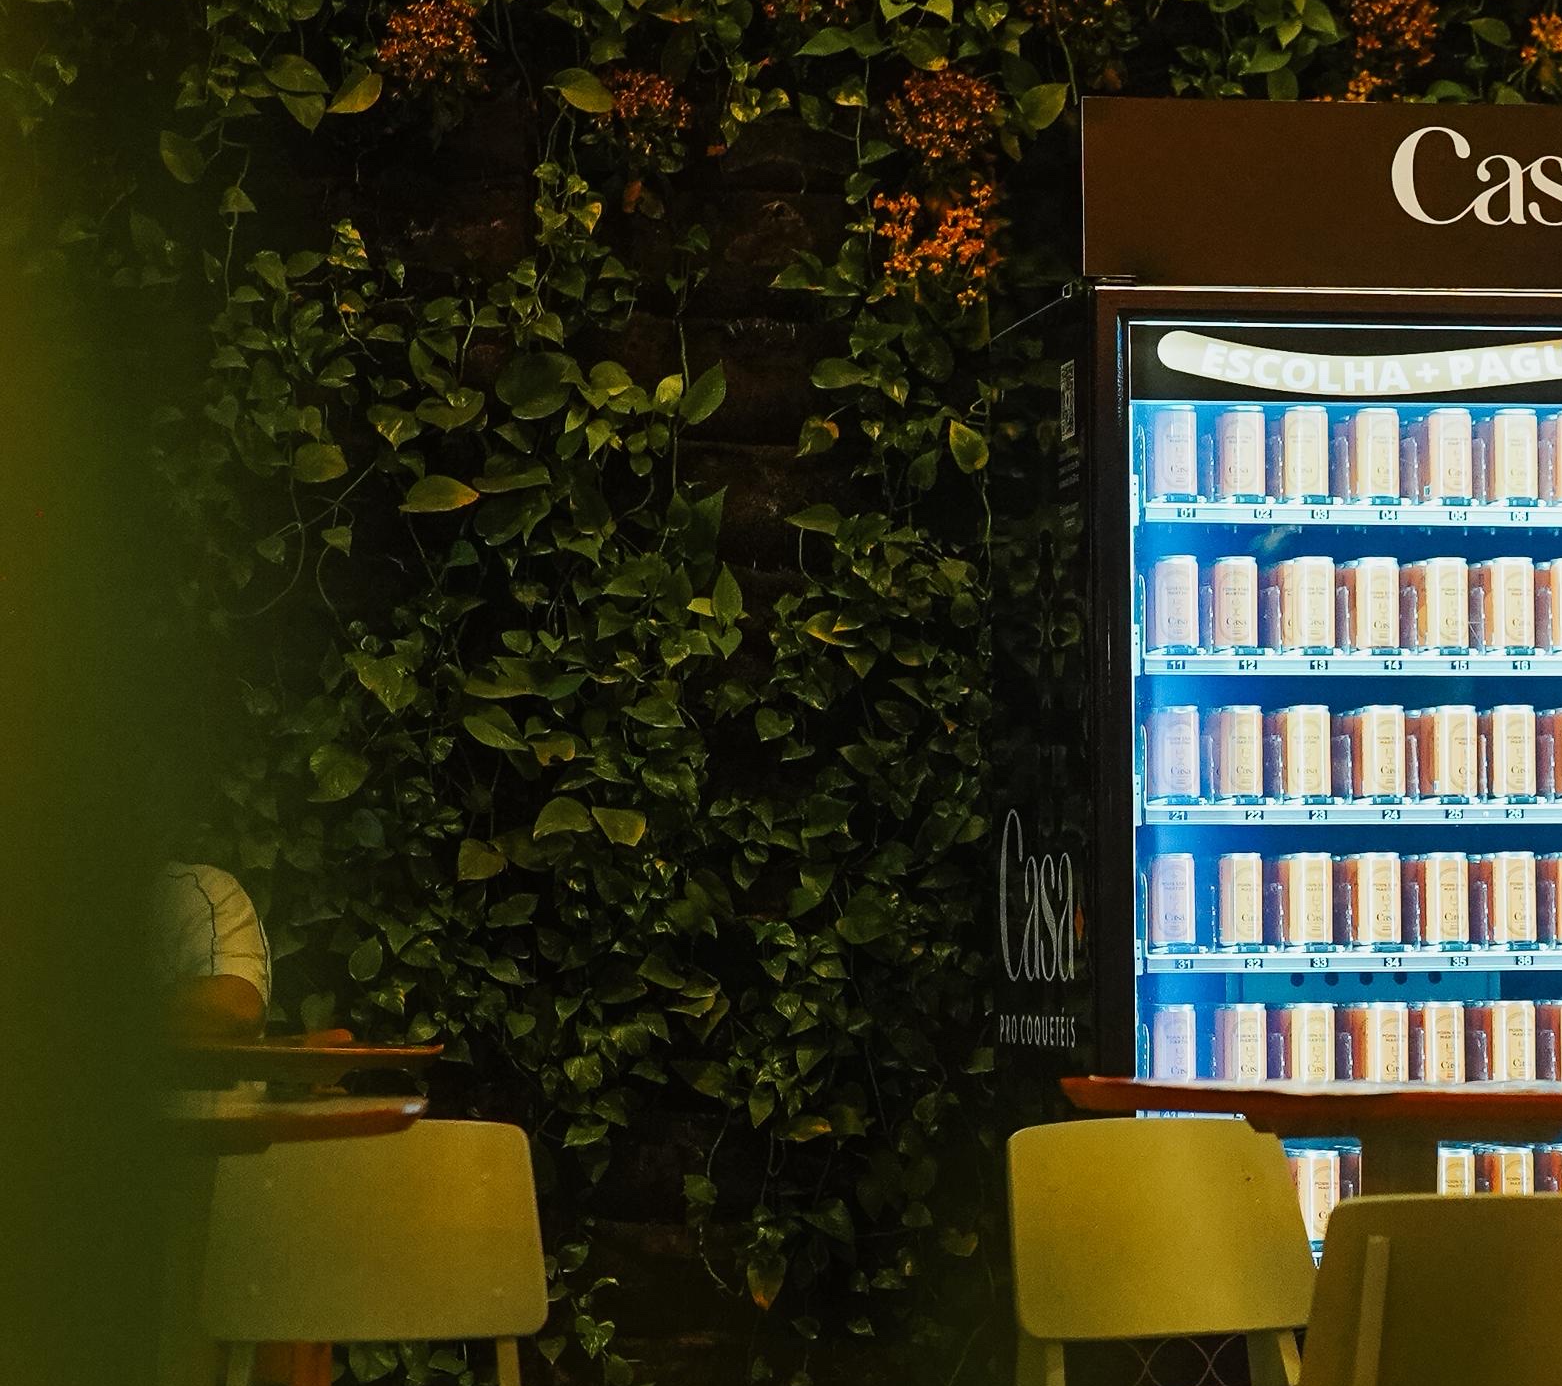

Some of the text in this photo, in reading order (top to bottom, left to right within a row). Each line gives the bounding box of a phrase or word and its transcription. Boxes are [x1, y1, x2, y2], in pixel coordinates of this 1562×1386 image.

[1200, 342, 1410, 393] ESCOLHA
[1255, 509, 1270, 519] 02
[1381, 510, 1397, 520] 04
[1170, 660, 1184, 670] 11
[1241, 660, 1256, 670] 12
[1312, 660, 1327, 670] 13
[1386, 660, 1401, 670] 14
[1452, 660, 1468, 670] 15
[1172, 811, 1185, 820] 21
[1248, 811, 1262, 820] 22
[1311, 810, 1326, 820] 23
[1384, 810, 1399, 820] 24
[1448, 809, 1462, 819] 25
[1000, 808, 1074, 982] Casa
[1178, 959, 1192, 969] 31
[1247, 959, 1261, 968] 32
[1313, 958, 1328, 968] 33
[1385, 958, 1400, 968] 34
[1452, 957, 1467, 966] 35
[1517, 956, 1532, 965] 36
[1000, 1007, 1076, 1049] PRO COQUETÉIS
